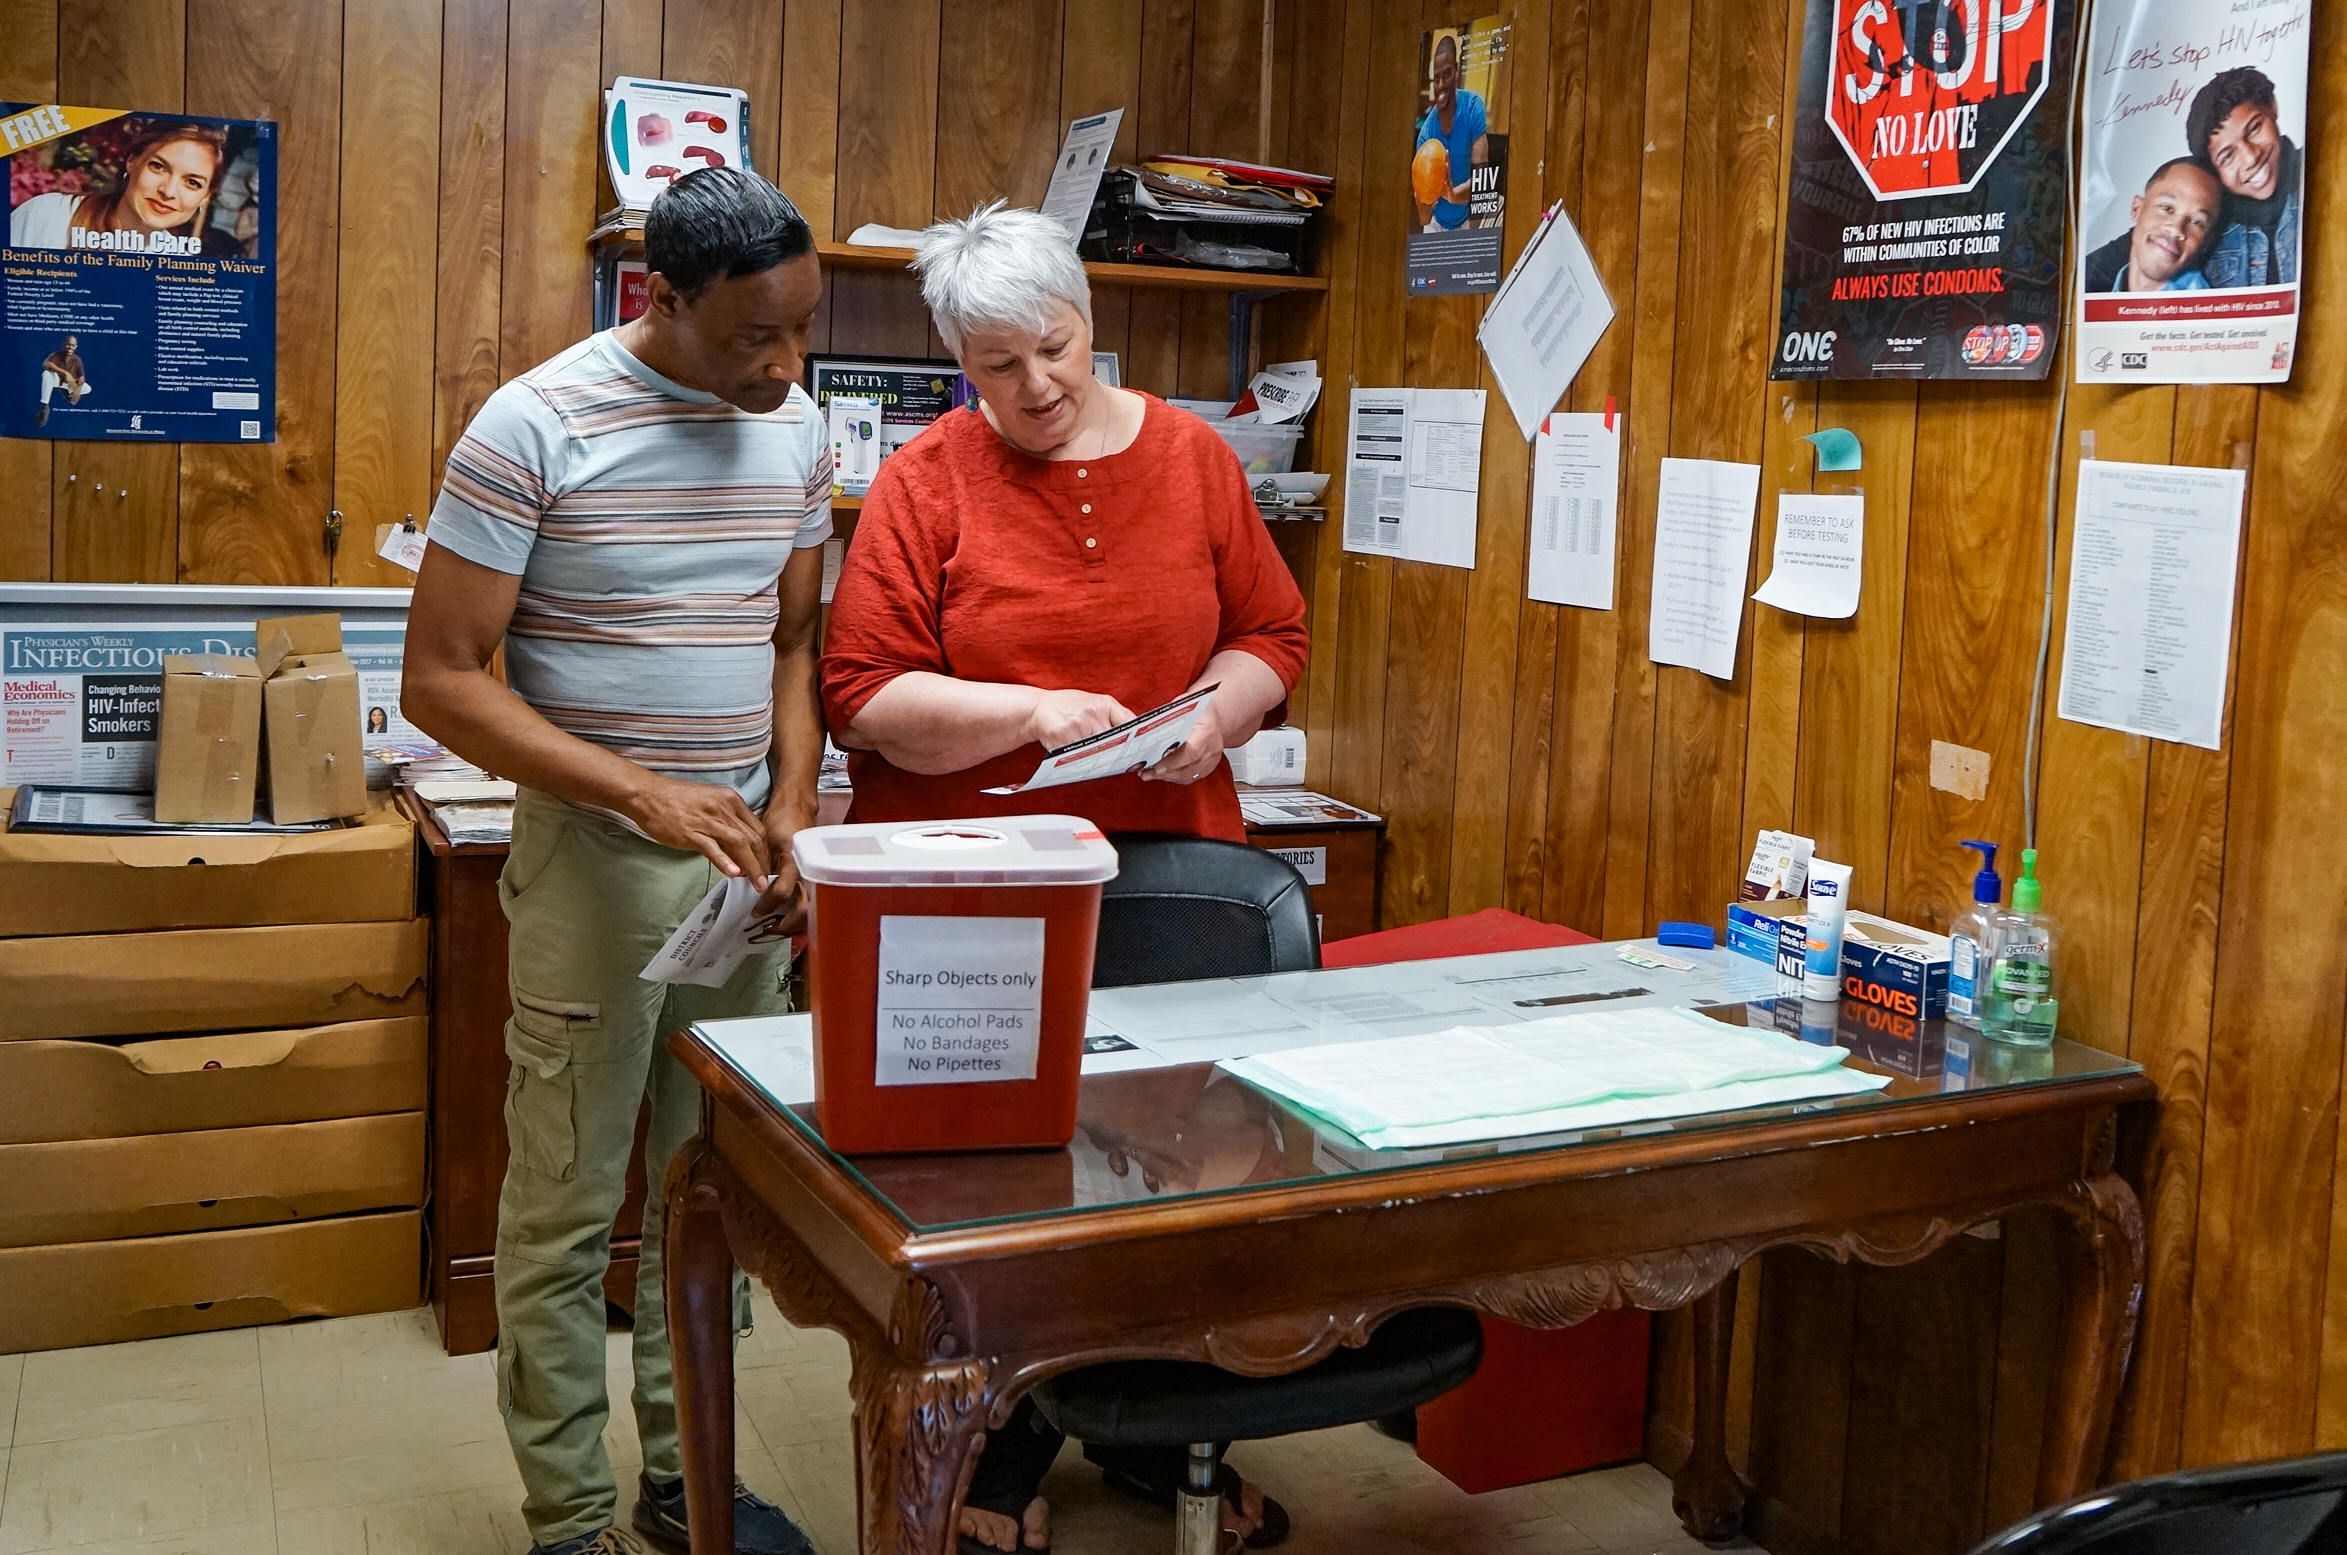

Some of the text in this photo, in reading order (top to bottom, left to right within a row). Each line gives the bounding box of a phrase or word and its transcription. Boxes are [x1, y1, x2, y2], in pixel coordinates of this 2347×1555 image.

[2104, 25, 2164, 75] Let's
[2168, 43, 2211, 72] stop
[0, 104, 71, 150] FREE
[1872, 104, 1979, 159] NO LOVE
[1472, 166, 1500, 192] HIV
[1472, 192, 1498, 201] TREATMENT
[1471, 201, 1498, 214] WORKS
[1842, 212, 2006, 243] 67% OF NEW HIV INFECTIONS ARE
[71, 227, 202, 255] Health Care
[1843, 236, 2000, 264] WITHIN COMMUNITIES OF COLOR
[2, 249, 266, 274] Benefits of the Family Planning Waiver
[4, 267, 78, 278] Eligible Recipients
[155, 274, 216, 284] Services Include
[628, 282, 648, 296] Wha
[1832, 267, 2004, 300] ALWAYS USE CONDOMS.
[636, 298, 643, 310] is
[2117, 306, 2158, 316] Kennedy
[1782, 330, 1838, 362] ONE
[2122, 354, 2147, 366] CDC
[831, 374, 888, 388] SAFETY:
[1784, 514, 1855, 529] REMEMBER TO ASK
[1788, 528, 1848, 544] BEFORE TESTING
[24, 636, 134, 647] PHYSICIAN'S WEEKLY
[4, 680, 57, 692] Medical
[88, 684, 161, 696] Changing Behavio
[4, 690, 76, 701] Economics
[6, 710, 20, 718] Why
[34, 708, 66, 717] Physicians
[88, 698, 160, 714] HIV-Infect
[6, 718, 30, 726] Holding
[88, 717, 152, 733] Smokers
[1750, 868, 1768, 878] FABRIC
[1752, 862, 1774, 874] FLEXIBLE
[1810, 880, 1838, 896] Suave
[1781, 924, 1806, 939] Powder
[670, 929, 696, 959] DISTRICT
[678, 928, 708, 962] COUNCILS
[1780, 934, 1800, 948] Nitrile
[886, 970, 1037, 989] Sharp Objects only
[1844, 976, 1918, 1016] GLOVES
[892, 1014, 1023, 1028] No Alcohol Pads
[904, 1035, 1010, 1052] No Bandages
[908, 1056, 1001, 1073] No Pipettes
